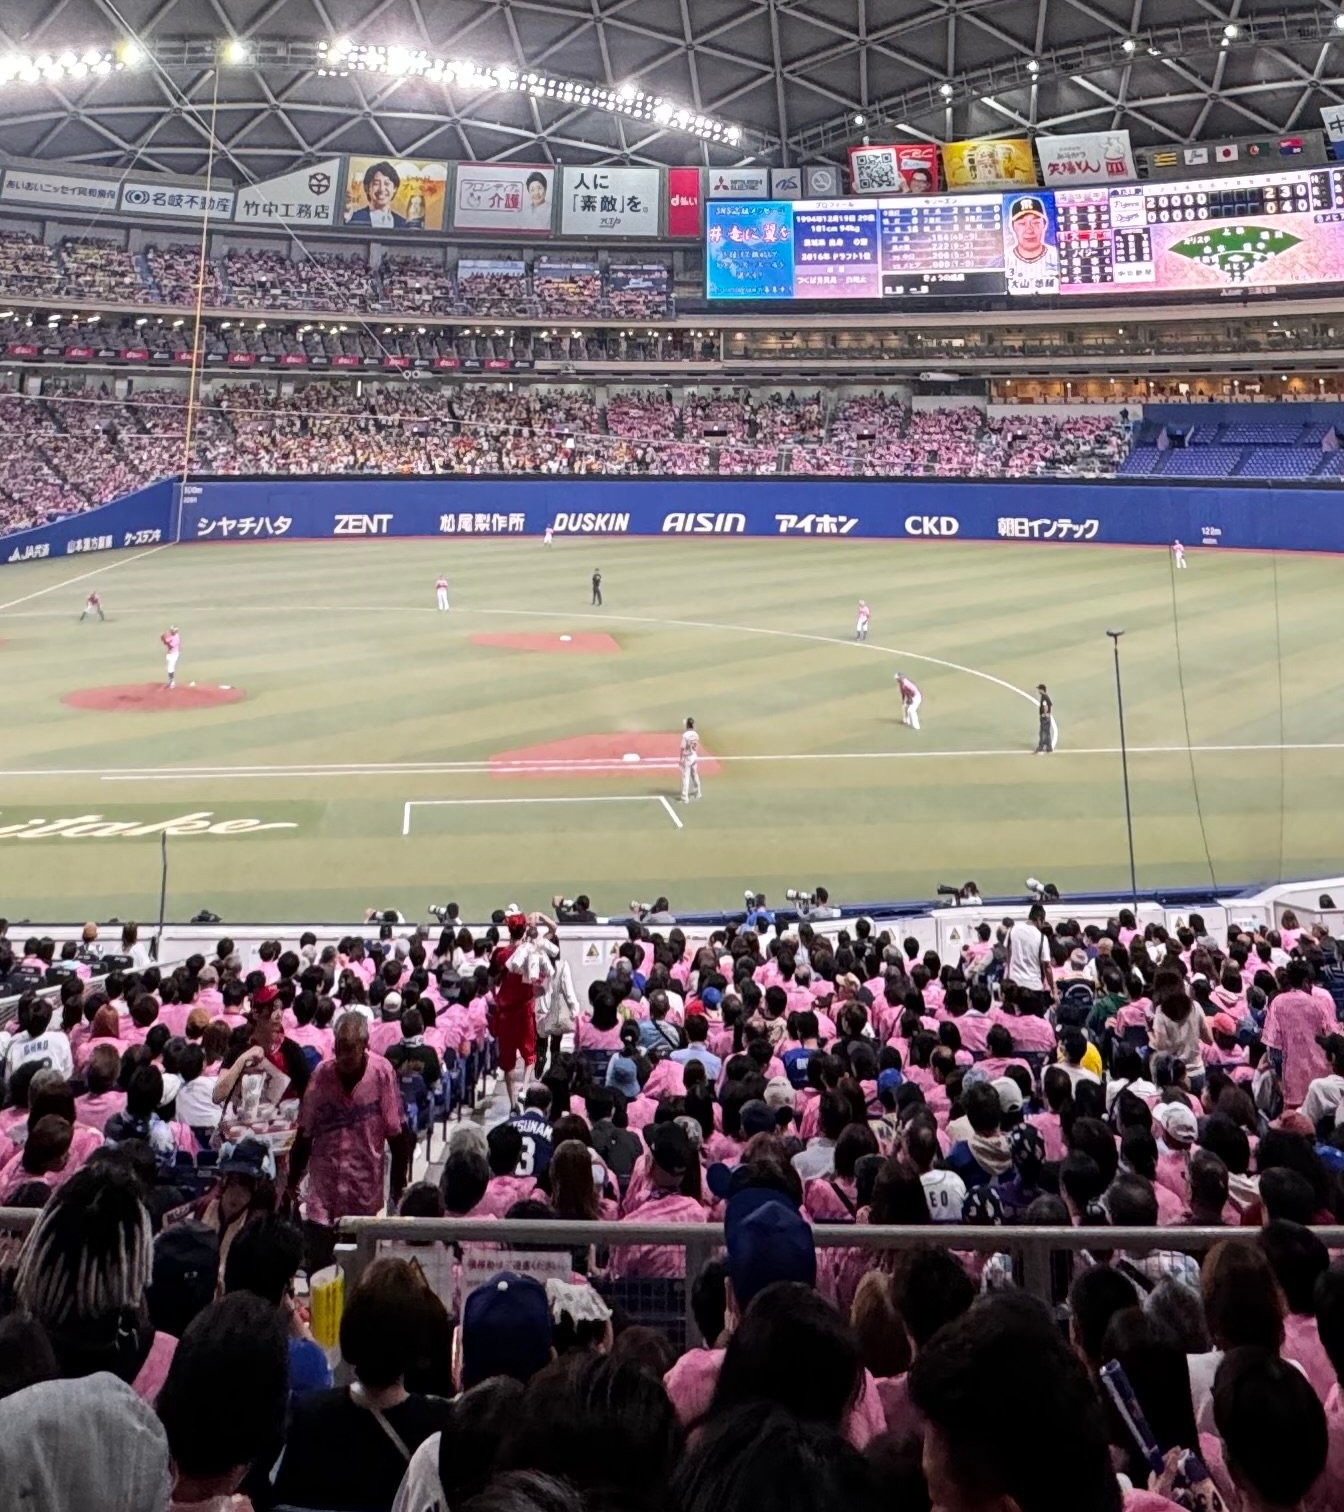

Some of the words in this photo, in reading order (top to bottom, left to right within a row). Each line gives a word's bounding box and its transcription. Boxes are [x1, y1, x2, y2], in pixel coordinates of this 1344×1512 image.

[899, 148, 934, 159] CBC
[573, 172, 610, 190] 人に
[152, 192, 232, 214] 名岐不動産
[242, 199, 330, 219] 竹中工務店
[488, 192, 521, 210] 介護
[572, 193, 649, 214] 「素敵」を。
[670, 194, 698, 207] d払い
[197, 515, 293, 537] シヤチハタ
[334, 513, 394, 534] ZENT
[439, 512, 526, 533] 松尾製作所
[553, 512, 631, 532] DUSKIN
[662, 512, 747, 533] AISIN
[774, 513, 860, 534] アイホン
[904, 515, 960, 536] CKD
[996, 516, 1100, 539] 朝日インテック
